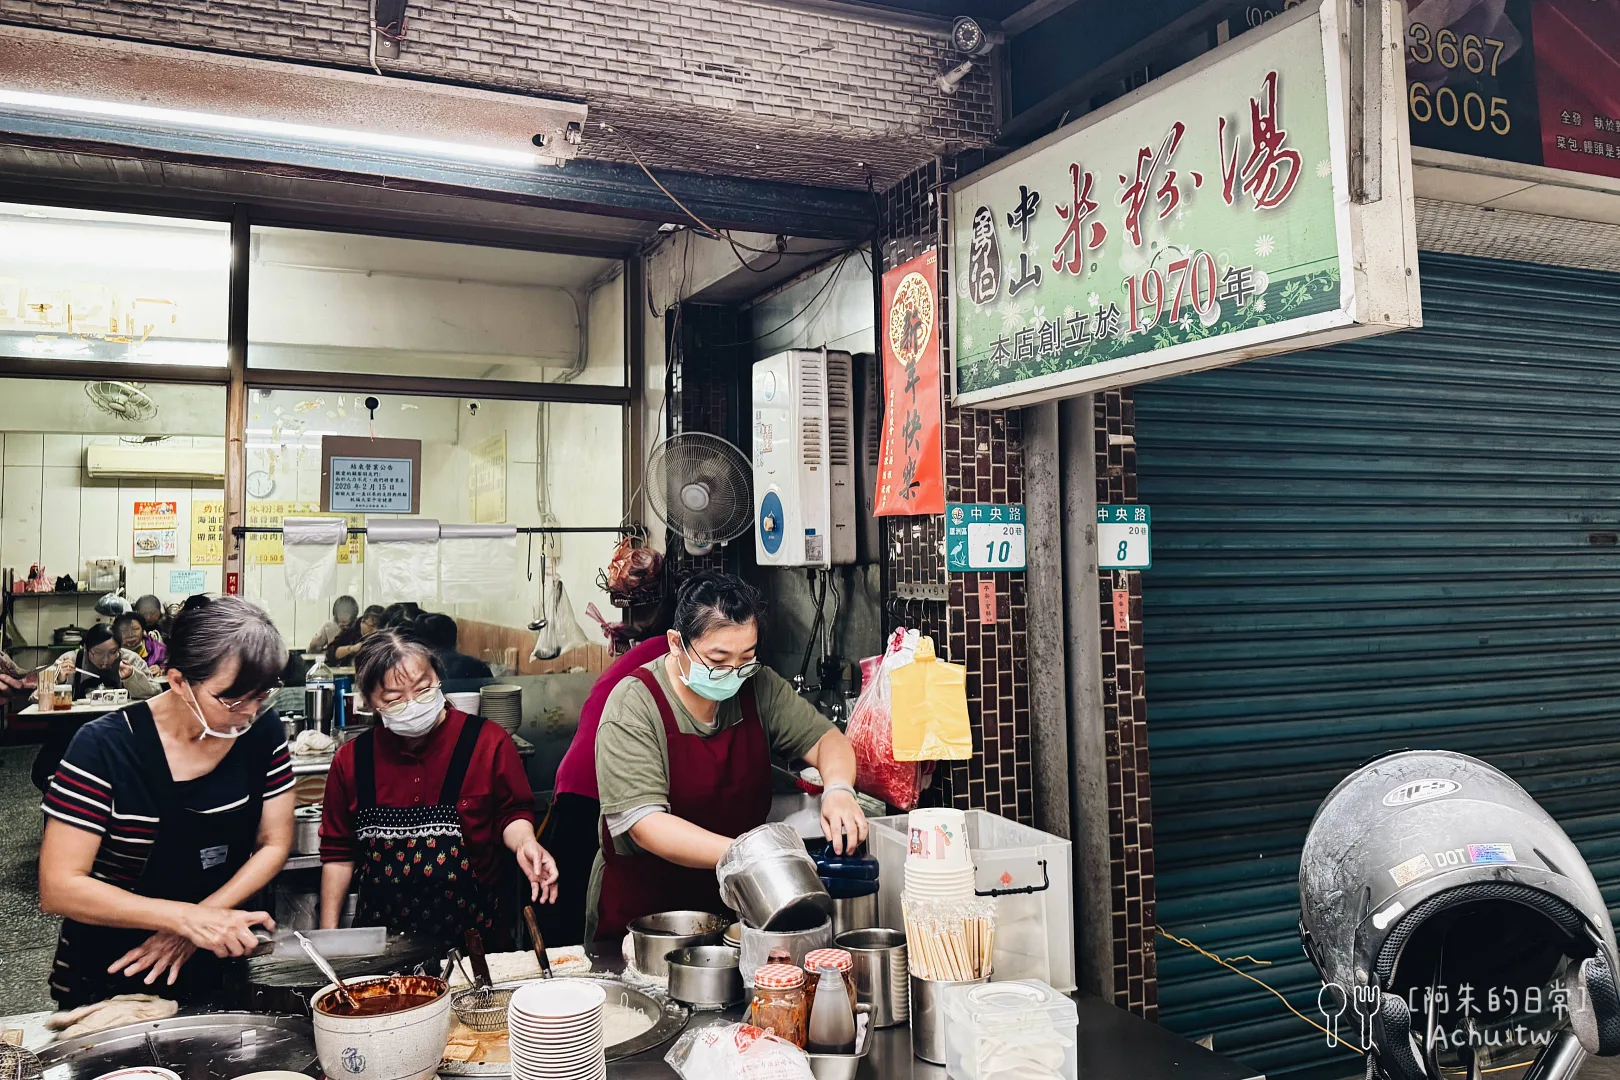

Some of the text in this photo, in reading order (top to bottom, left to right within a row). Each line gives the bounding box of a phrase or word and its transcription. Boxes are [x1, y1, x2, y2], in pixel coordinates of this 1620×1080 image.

[1409, 23, 1504, 76] 3667
[1409, 81, 1511, 136] 6005
[1050, 70, 1304, 275] 米粉湯
[1006, 185, 1042, 297] 中山
[970, 208, 998, 304] 勇伯
[898, 308, 923, 502] 新年快樂
[970, 506, 1021, 521] 中央路
[1097, 507, 1146, 521] 中央路
[1002, 526, 1022, 536] 20巷
[1128, 526, 1147, 536] 20巷
[985, 540, 1011, 563] 10
[1116, 540, 1128, 561] 8
[1434, 848, 1467, 868] DOT
